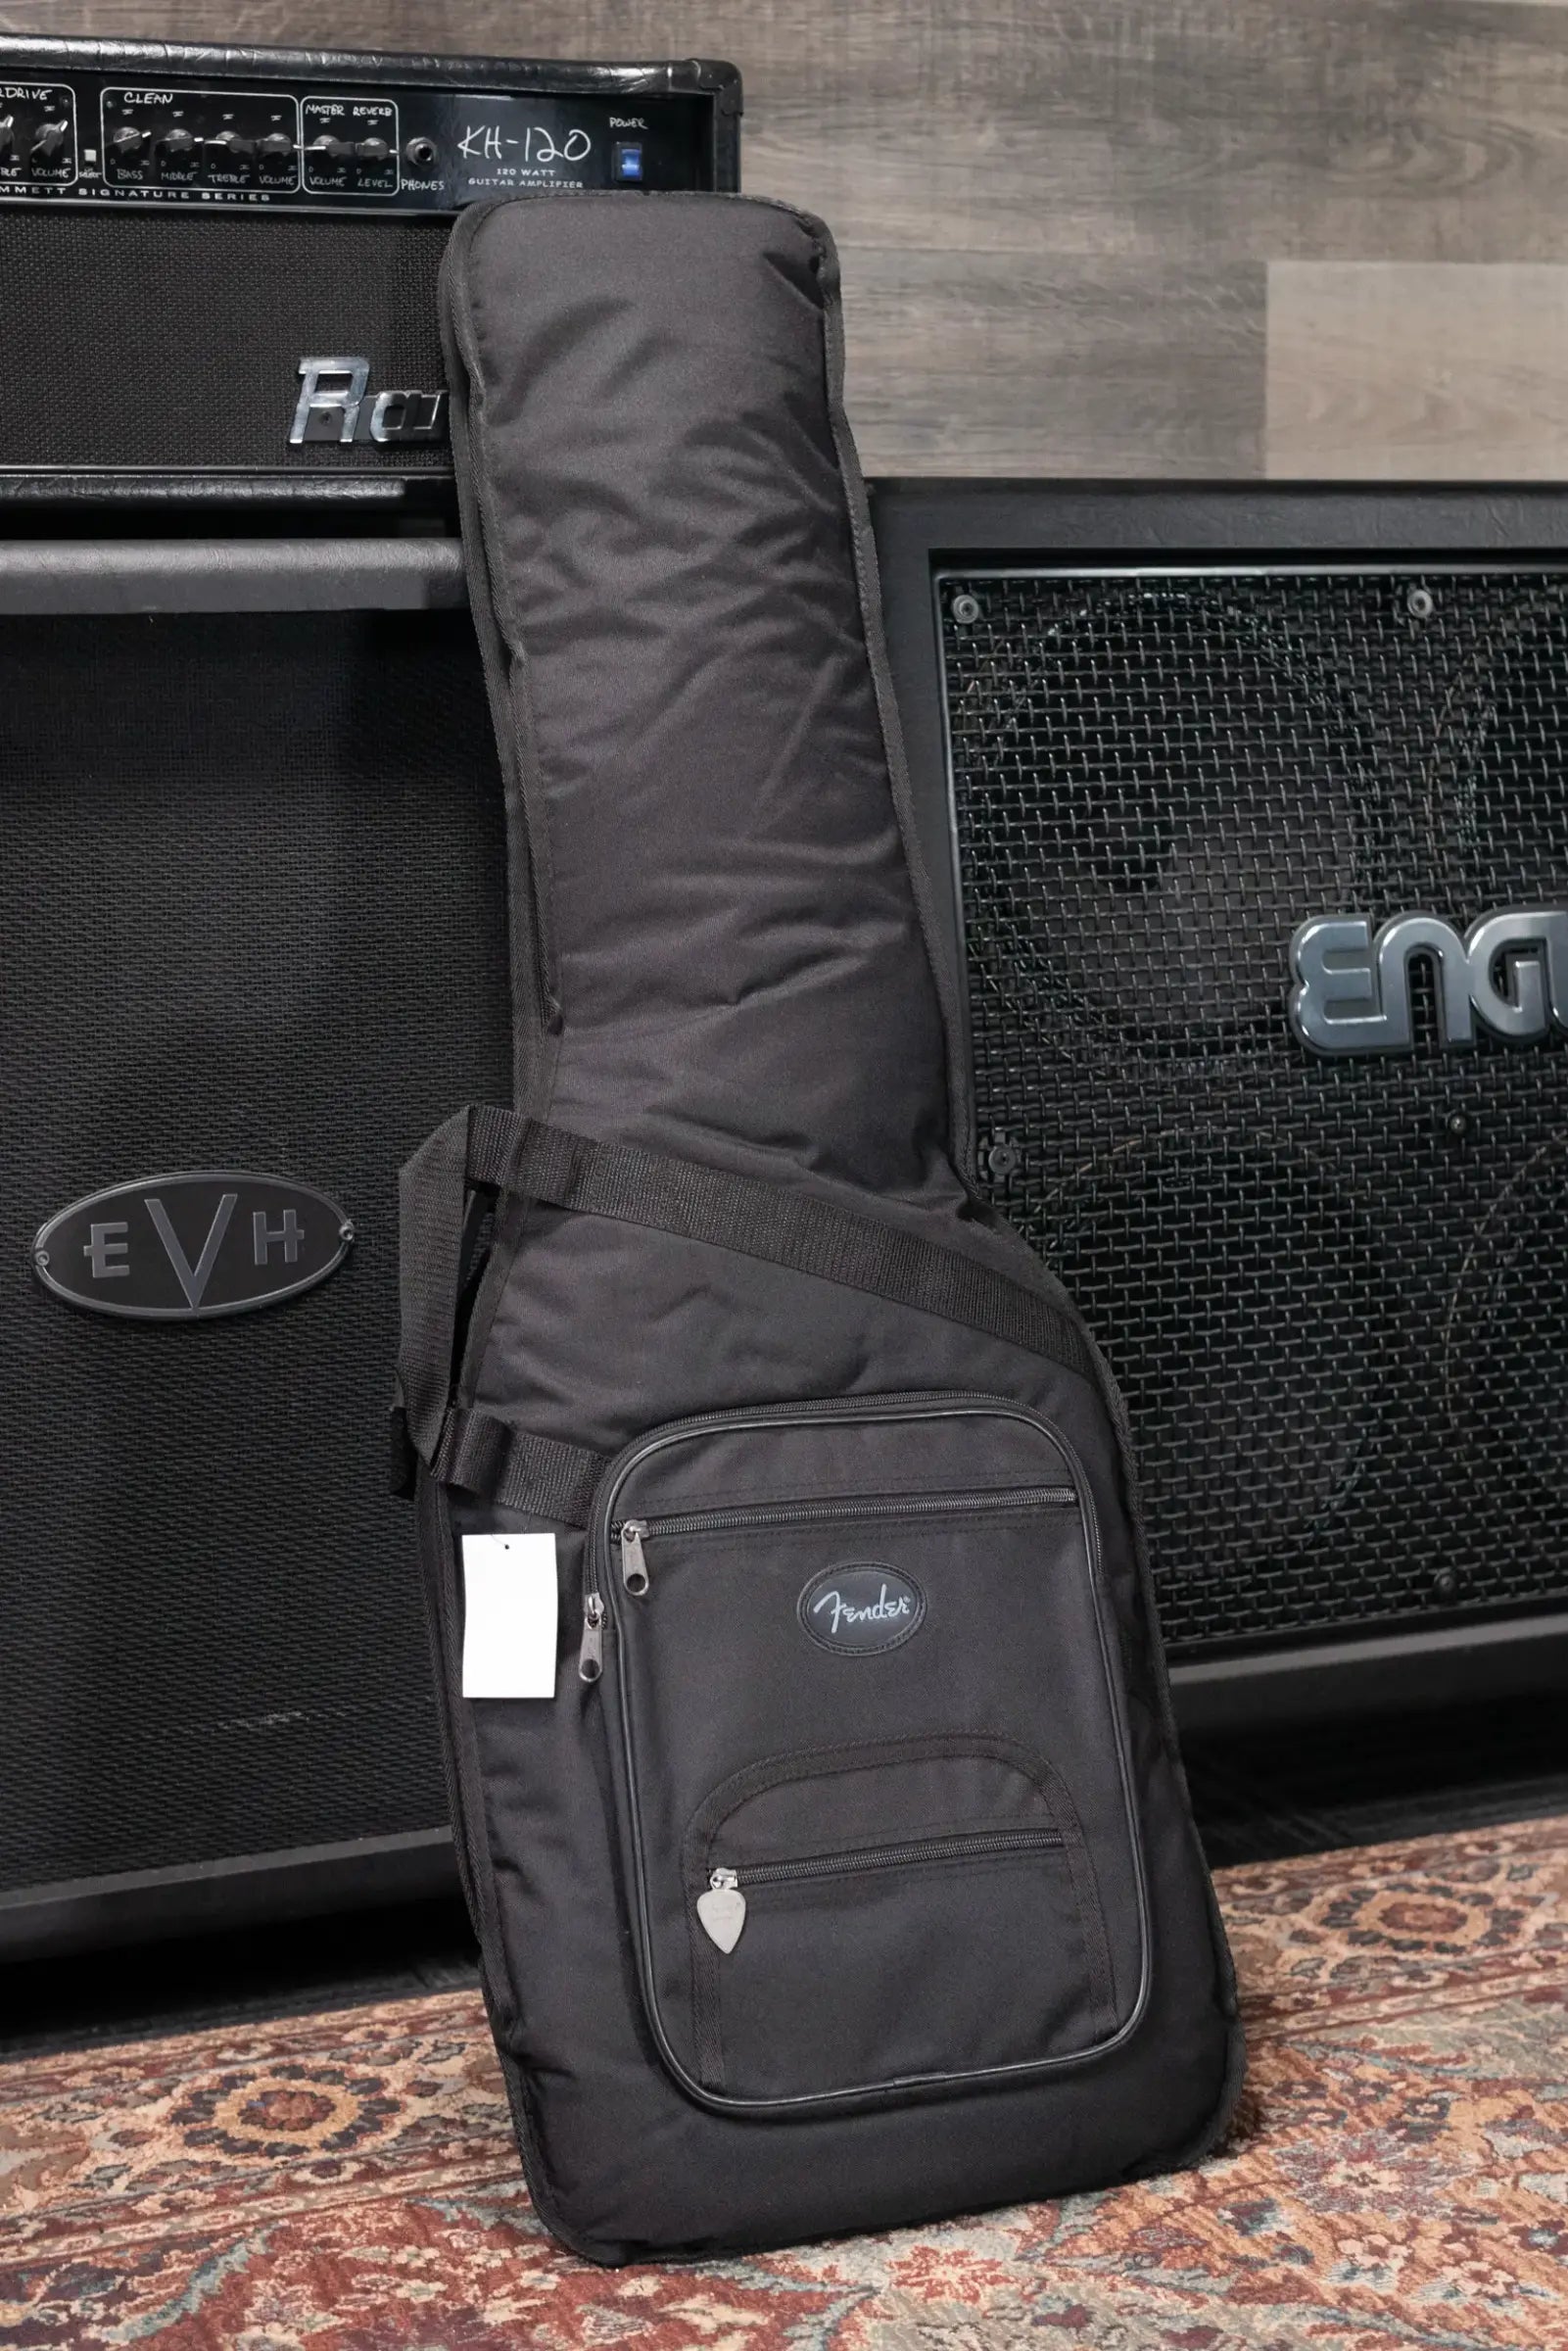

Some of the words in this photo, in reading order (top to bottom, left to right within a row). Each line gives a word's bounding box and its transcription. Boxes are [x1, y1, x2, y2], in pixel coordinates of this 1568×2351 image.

[123, 91, 173, 105] CLEAN
[305, 104, 345, 116] MASTER
[353, 106, 393, 117] REVERB
[609, 117, 648, 129] POWER
[457, 125, 592, 163] KH-120
[31, 168, 71, 178] VOLUME
[117, 168, 144, 180] BASS
[161, 170, 198, 181] MIDDLE
[497, 168, 516, 176] 120
[208, 173, 251, 184] TREBLE
[259, 174, 297, 186] VOLUME
[309, 175, 345, 186] VOLUME
[357, 178, 393, 188] LEVEL
[401, 178, 445, 191] PHONES
[468, 177, 514, 186] GUITAR
[519, 179, 584, 189] AMPLIFIER
[78, 188, 190, 200] SIGNATURE
[83, 1193, 305, 1311] EVH
